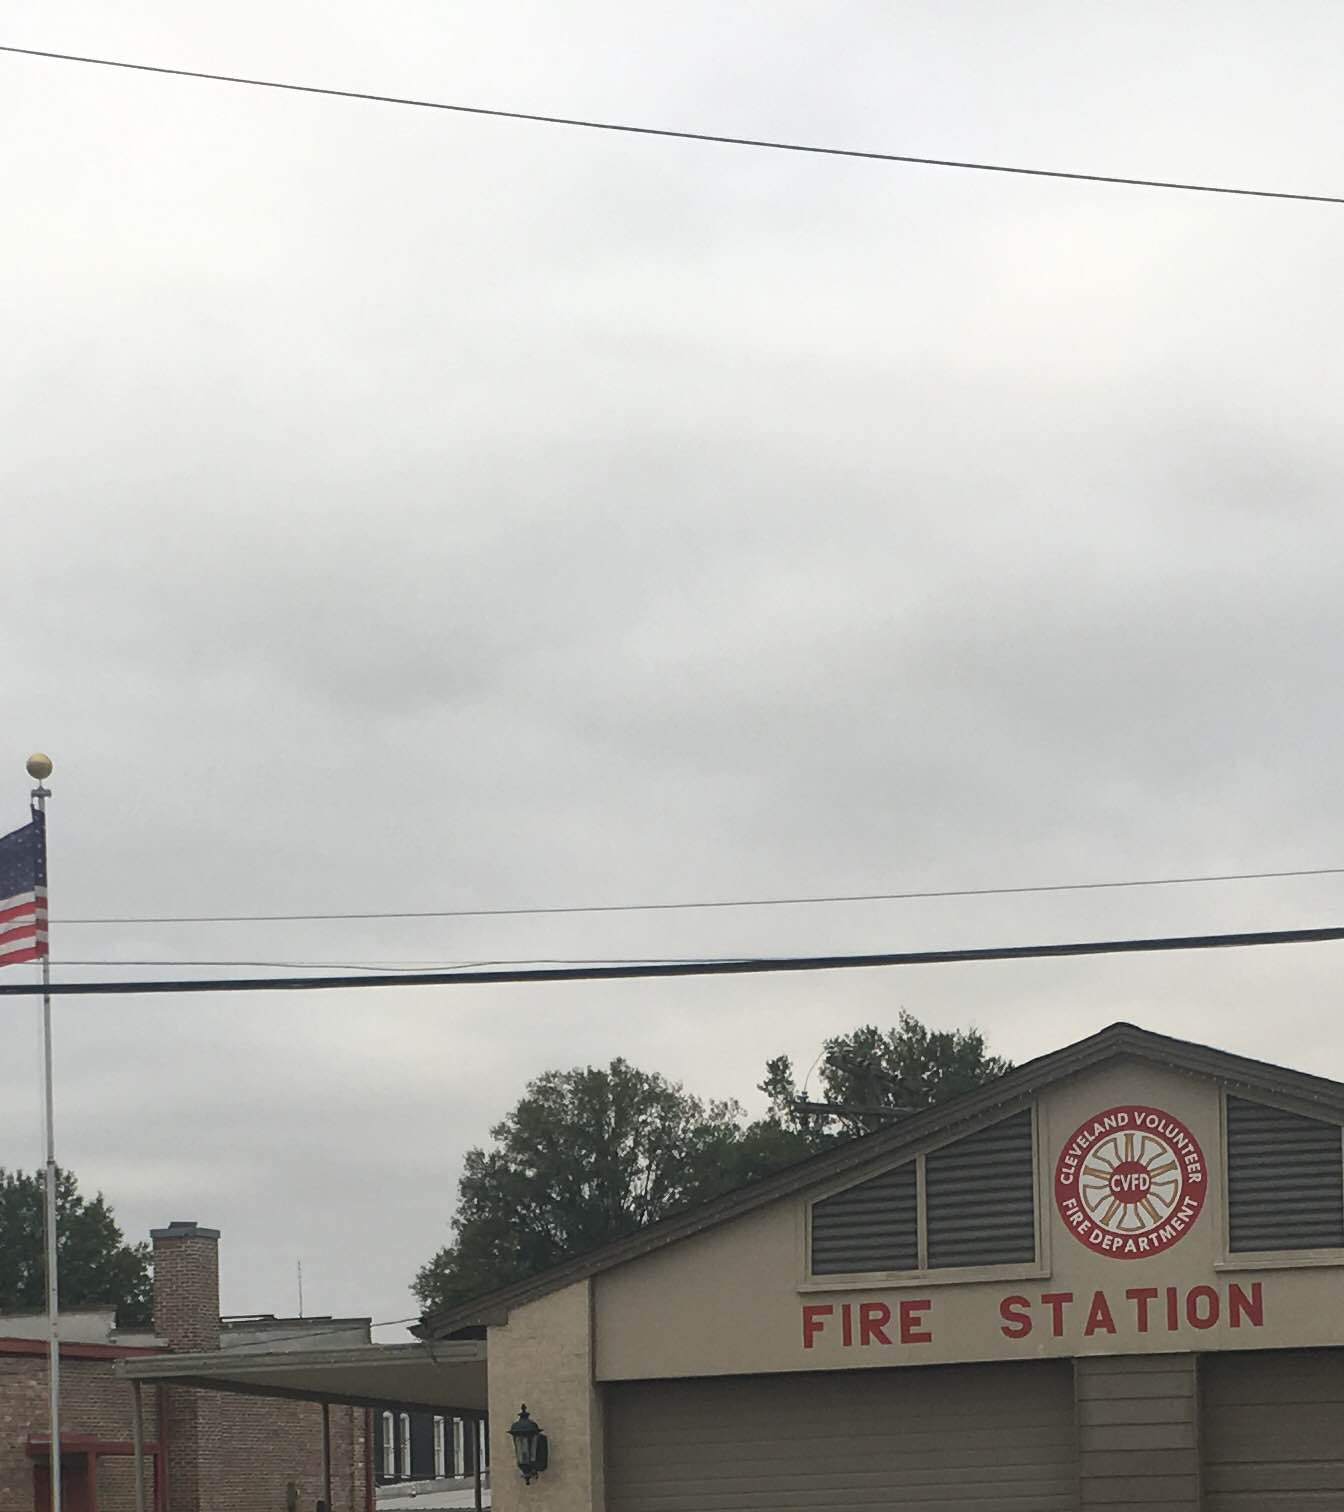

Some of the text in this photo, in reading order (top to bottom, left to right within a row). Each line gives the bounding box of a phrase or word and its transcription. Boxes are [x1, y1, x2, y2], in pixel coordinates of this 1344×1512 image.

[1060, 1111, 1202, 1185] CLEVELAND VOLUNTEER
[1110, 1173, 1150, 1192] CVFD
[1062, 1195, 1199, 1253] FIRE DEPARTMENT
[801, 1300, 933, 1349] FIRE
[999, 1281, 1264, 1340] STATION
